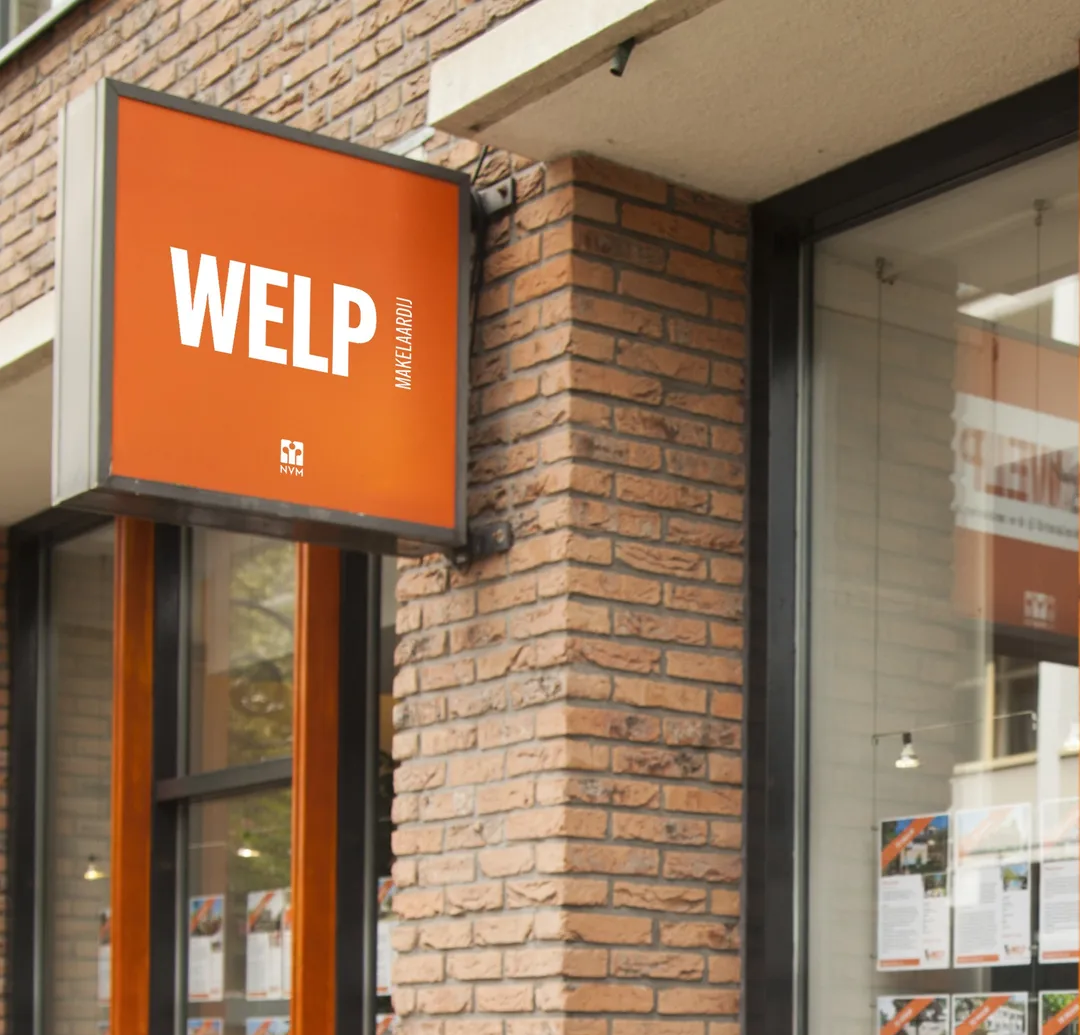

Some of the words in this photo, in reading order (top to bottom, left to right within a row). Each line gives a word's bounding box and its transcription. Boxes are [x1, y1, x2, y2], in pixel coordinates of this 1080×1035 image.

[170, 246, 377, 377] WELP
[395, 297, 413, 390] MAKELAARDIJ
[280, 465, 303, 477] NVM
